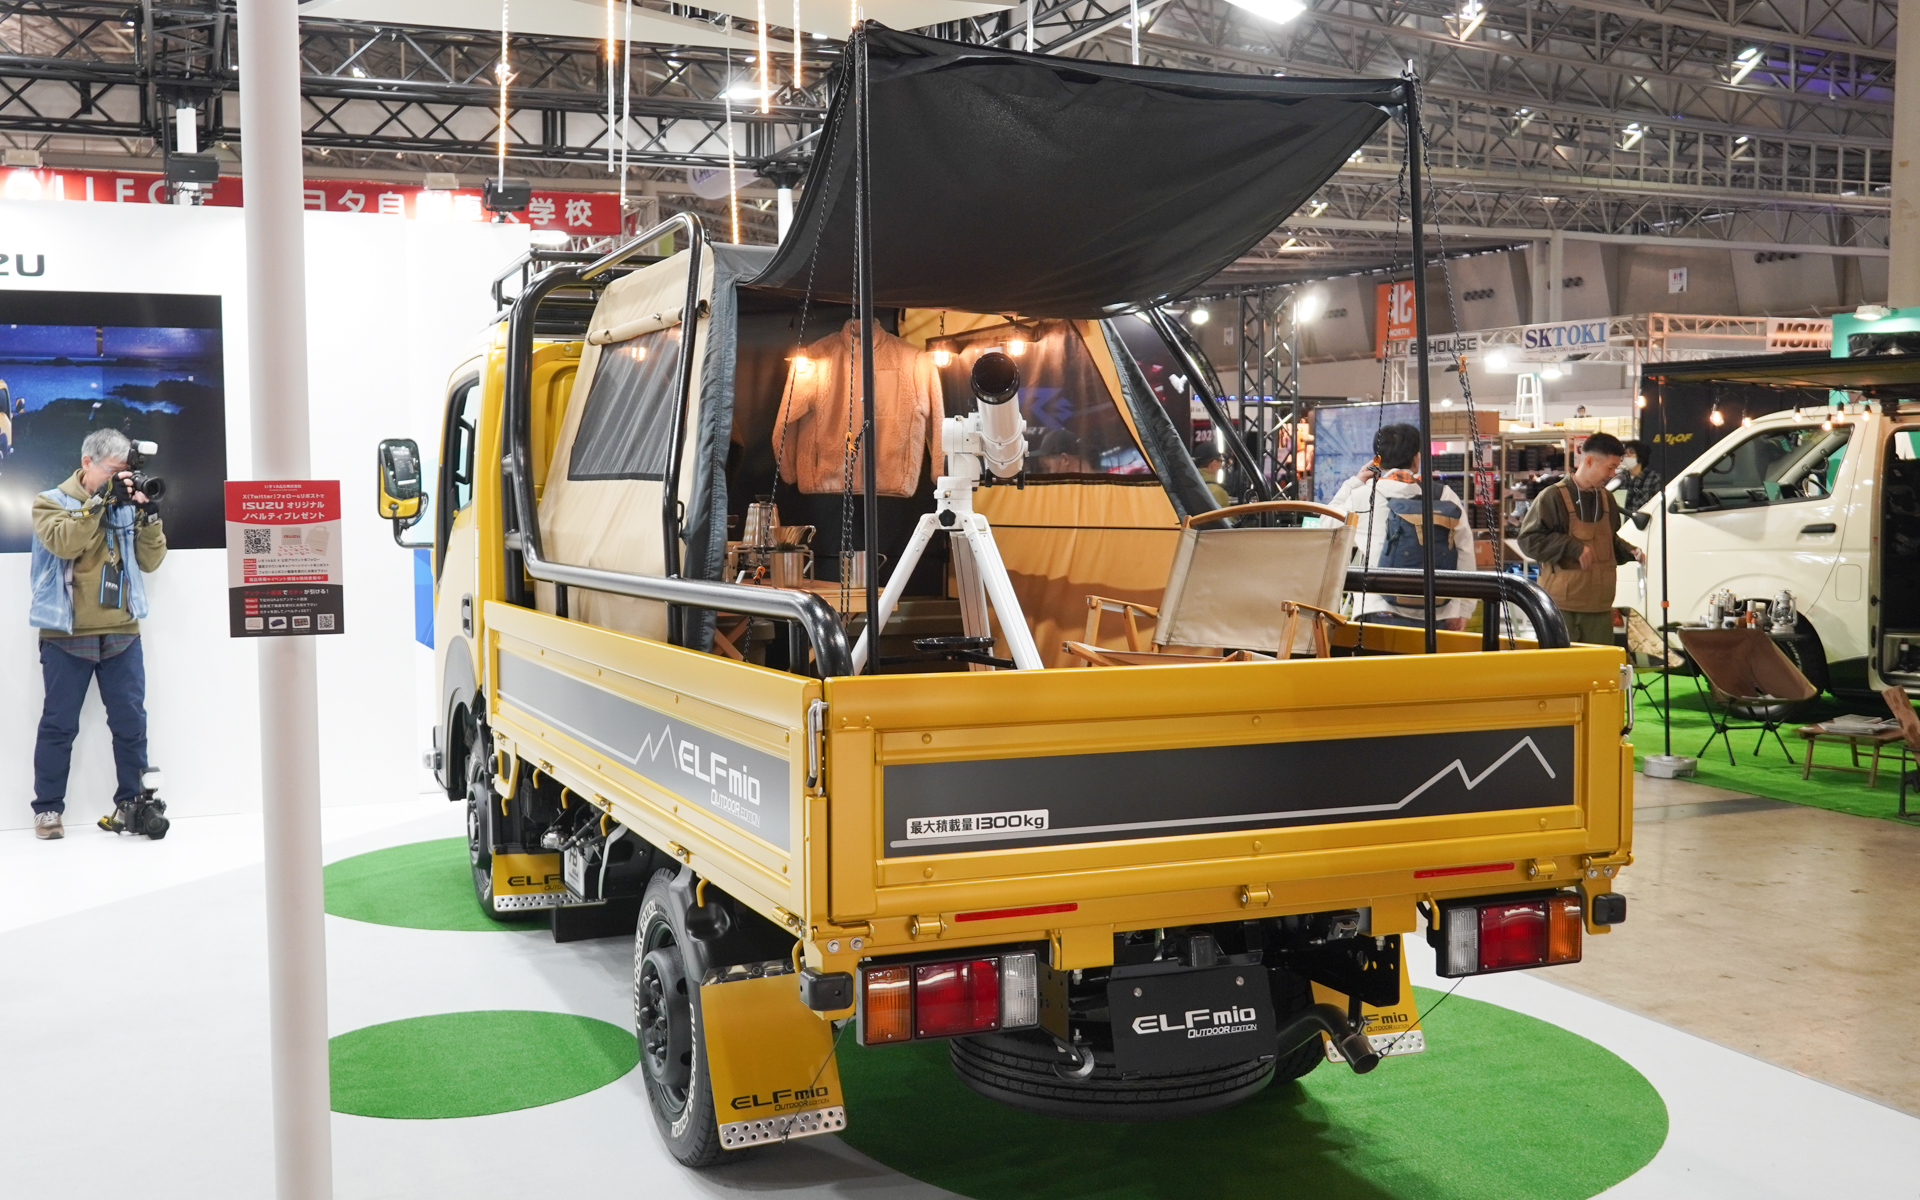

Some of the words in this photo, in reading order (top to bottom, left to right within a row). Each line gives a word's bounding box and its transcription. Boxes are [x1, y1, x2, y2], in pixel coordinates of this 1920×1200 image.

[1388, 283, 1412, 325] 北
[1388, 327, 1410, 336] NORTH
[1525, 322, 1606, 349] SKTOKI
[242, 501, 284, 510] ISUZU
[286, 501, 325, 509] オリジナル
[242, 512, 325, 520] ノベルティプレゼント
[710, 788, 740, 818] OUTDOOR
[910, 817, 973, 835] 最大積載量
[507, 874, 560, 886] ELF
[1187, 1025, 1231, 1039] OUTDOOR
[1231, 1023, 1258, 1033] EDITION
[1366, 1024, 1393, 1033] OUTDOOR
[774, 1100, 808, 1112] OUTDOOR
